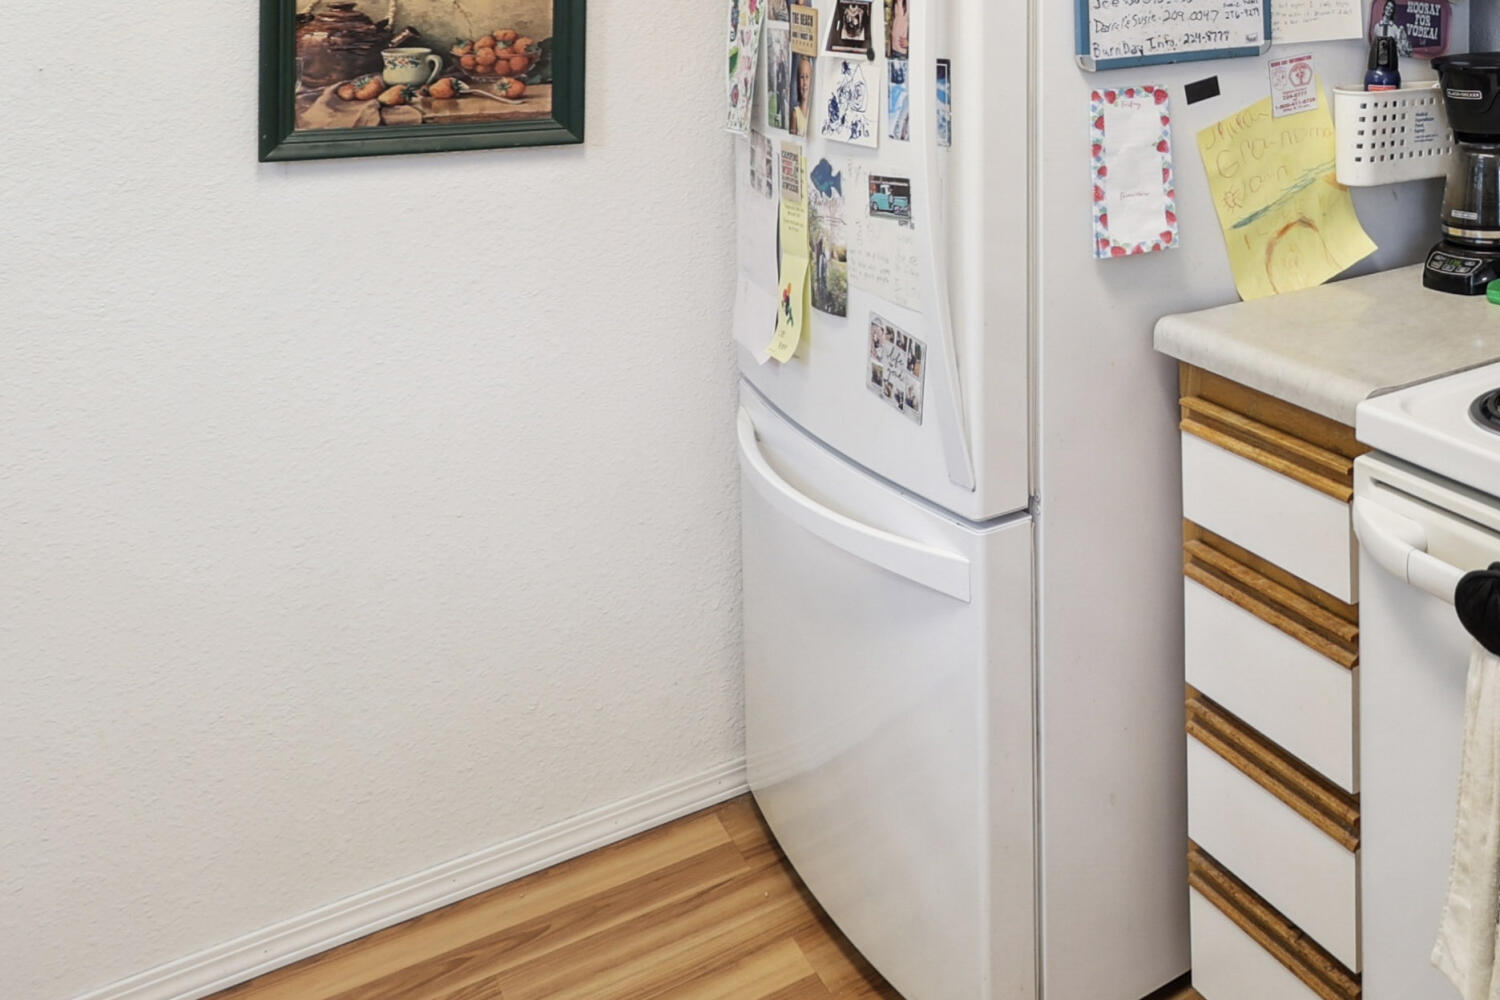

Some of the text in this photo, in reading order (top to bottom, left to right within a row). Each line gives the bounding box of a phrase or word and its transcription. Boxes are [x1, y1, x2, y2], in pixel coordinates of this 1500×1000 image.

[1407, 1, 1441, 16] HOORAY
[1415, 14, 1431, 26] FOR
[1406, 23, 1438, 39] VODKA!
